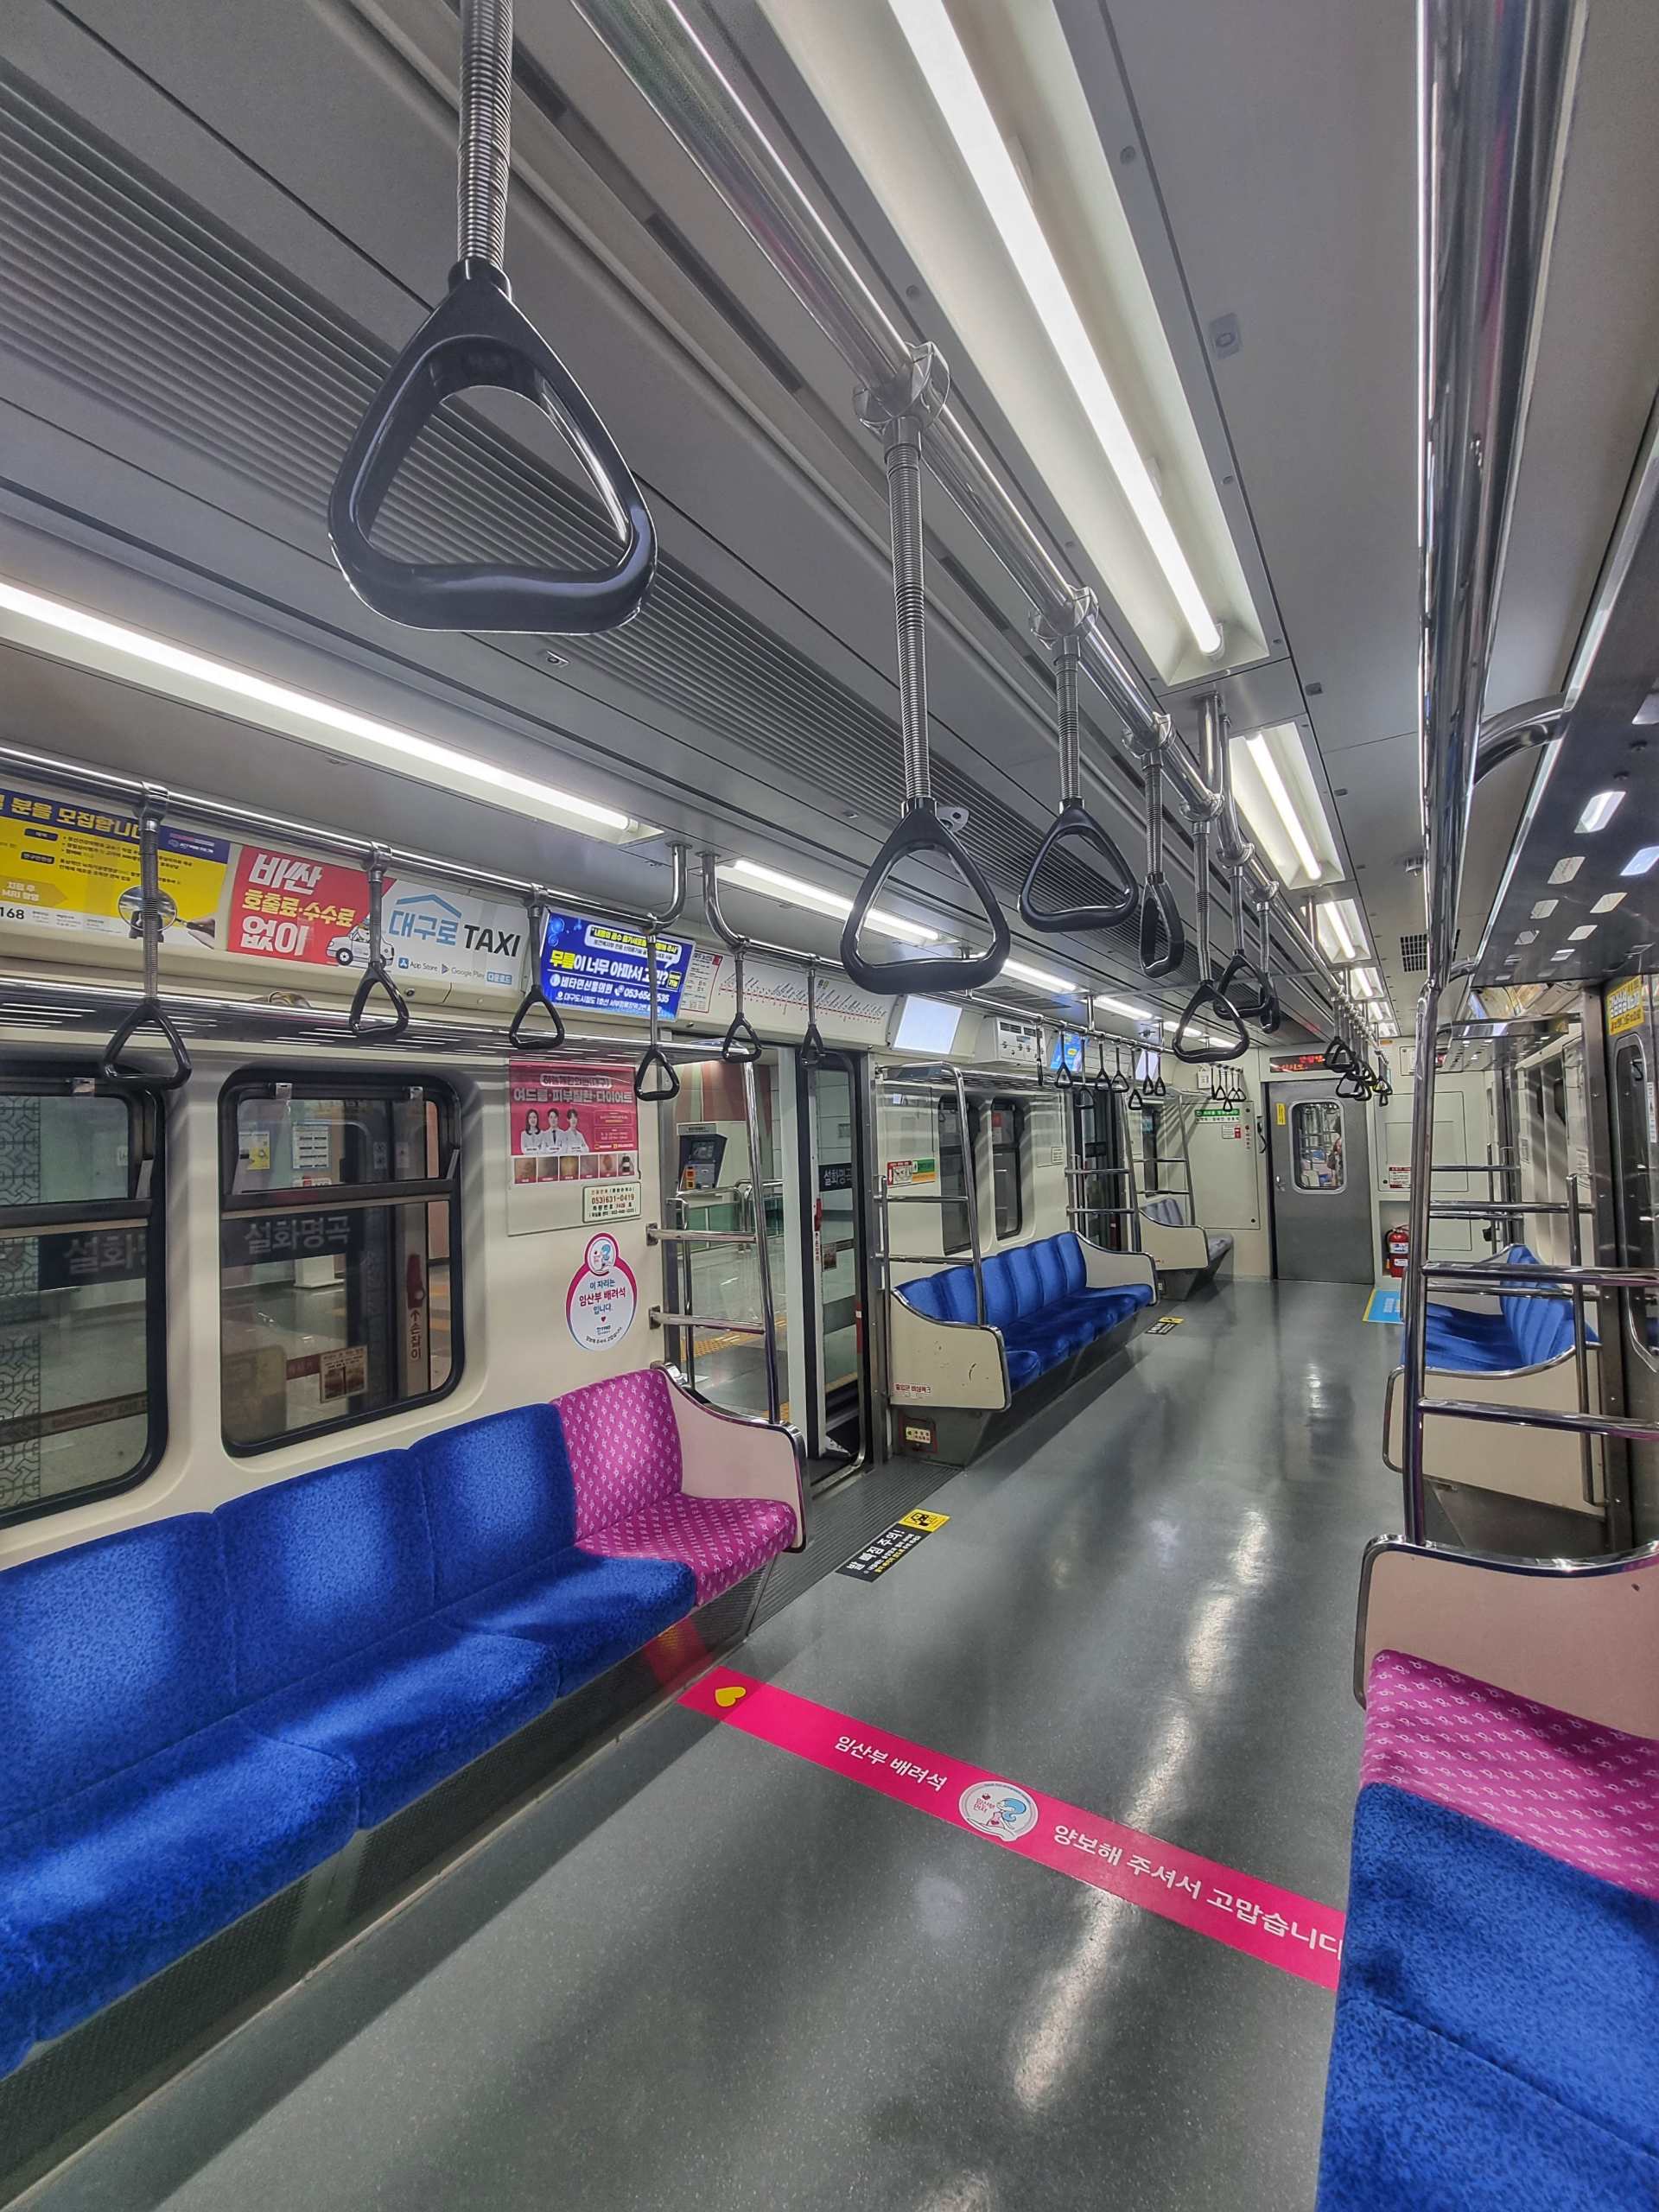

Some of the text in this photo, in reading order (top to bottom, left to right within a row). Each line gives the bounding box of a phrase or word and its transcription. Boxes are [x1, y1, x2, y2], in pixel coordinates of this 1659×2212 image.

[11, 798, 53, 820] 분을
[249, 854, 323, 895] 비싼
[240, 916, 309, 956] 없이
[389, 910, 522, 957] 대구로 TAXI
[423, 963, 438, 972] Store
[451, 967, 472, 977] Google
[586, 955, 610, 975] 너무
[611, 961, 644, 980] 아파서
[63, 1233, 146, 1275] 설화
[244, 1216, 351, 1255] 설화명곡
[579, 1287, 626, 1307] 임산부 배려석
[589, 1279, 616, 1290] 이 자리는
[593, 1303, 612, 1315] 입니다
[847, 1560, 866, 1571] 발
[858, 1546, 885, 1561] 빠짐
[877, 1529, 906, 1547] 주의!
[834, 1734, 949, 1792] 임산부 배려석
[1053, 1824, 1343, 1961] 양보해 주셔서 고맙습니다
